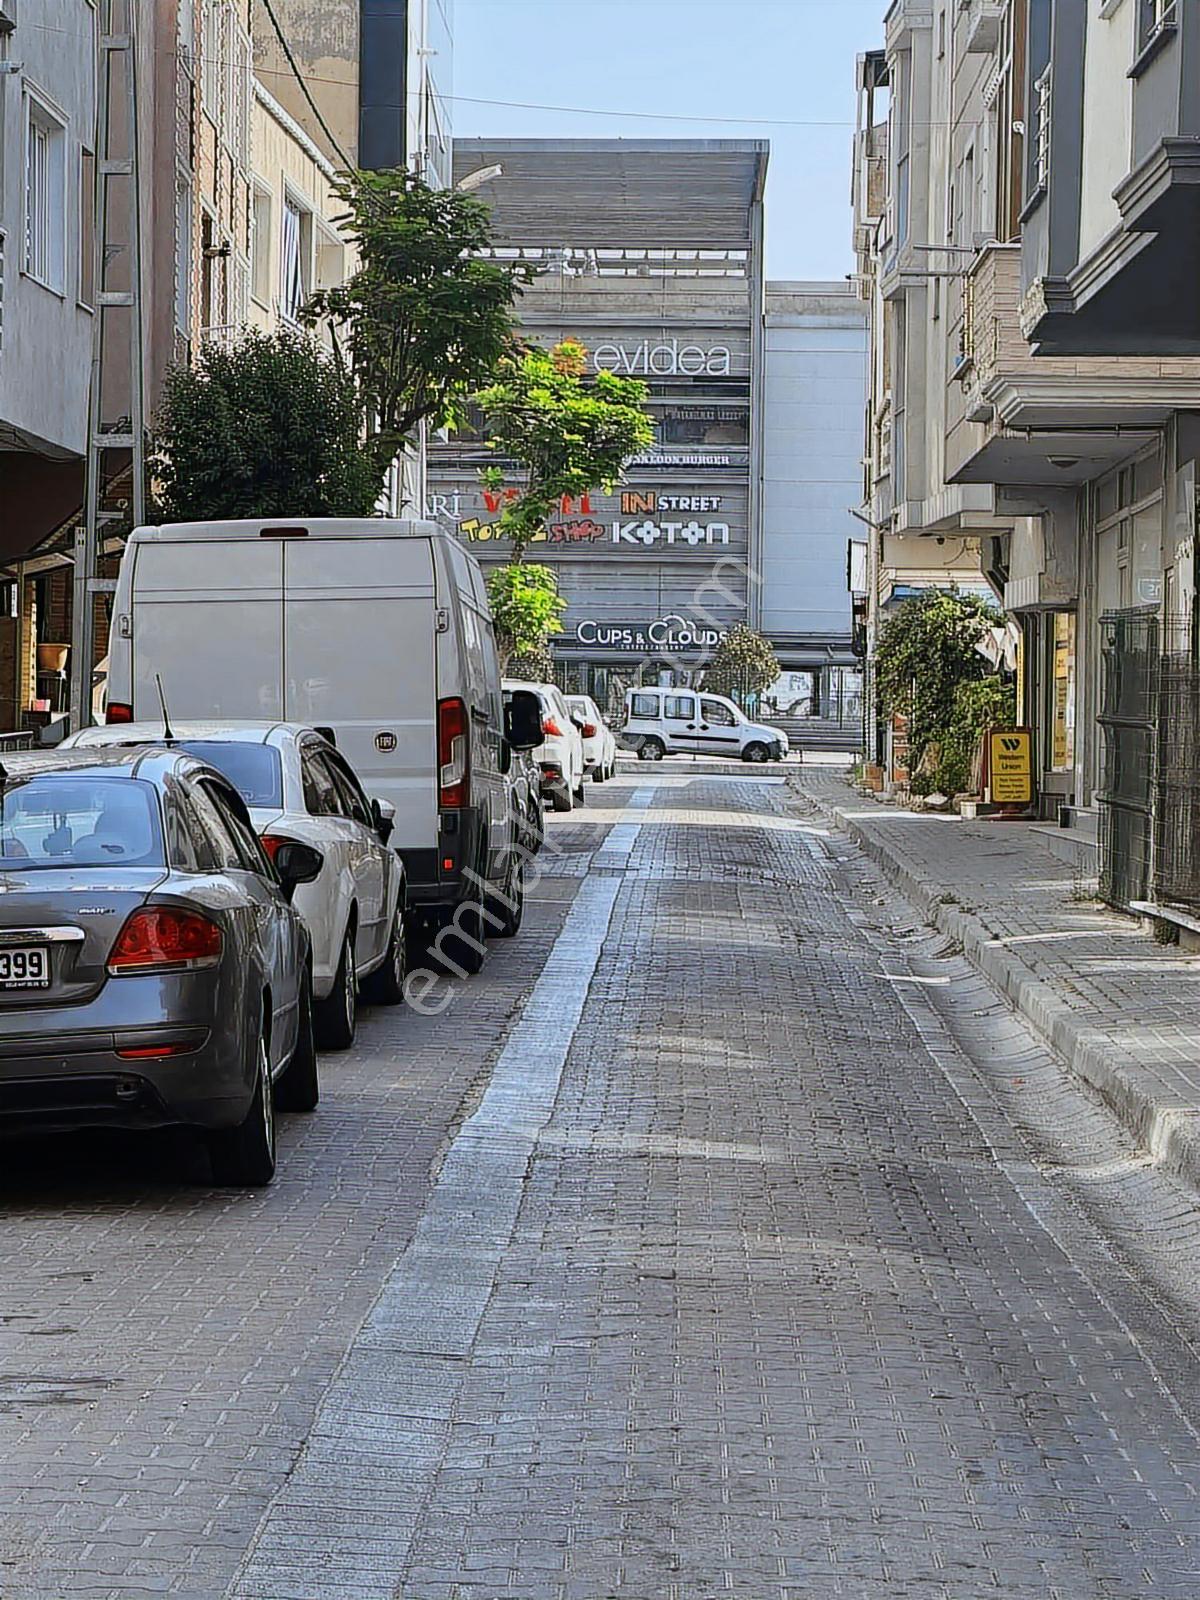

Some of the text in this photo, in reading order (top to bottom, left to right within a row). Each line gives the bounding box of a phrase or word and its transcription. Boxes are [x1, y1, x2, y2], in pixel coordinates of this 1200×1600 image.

[594, 339, 730, 375] evidea
[682, 455, 730, 464] BURGER
[621, 491, 722, 515] IN STREET
[549, 519, 606, 543] SHOP
[612, 520, 730, 545] KOTON
[577, 615, 729, 645] CUPS & CLOUDS
[0, 952, 42, 980] 399
